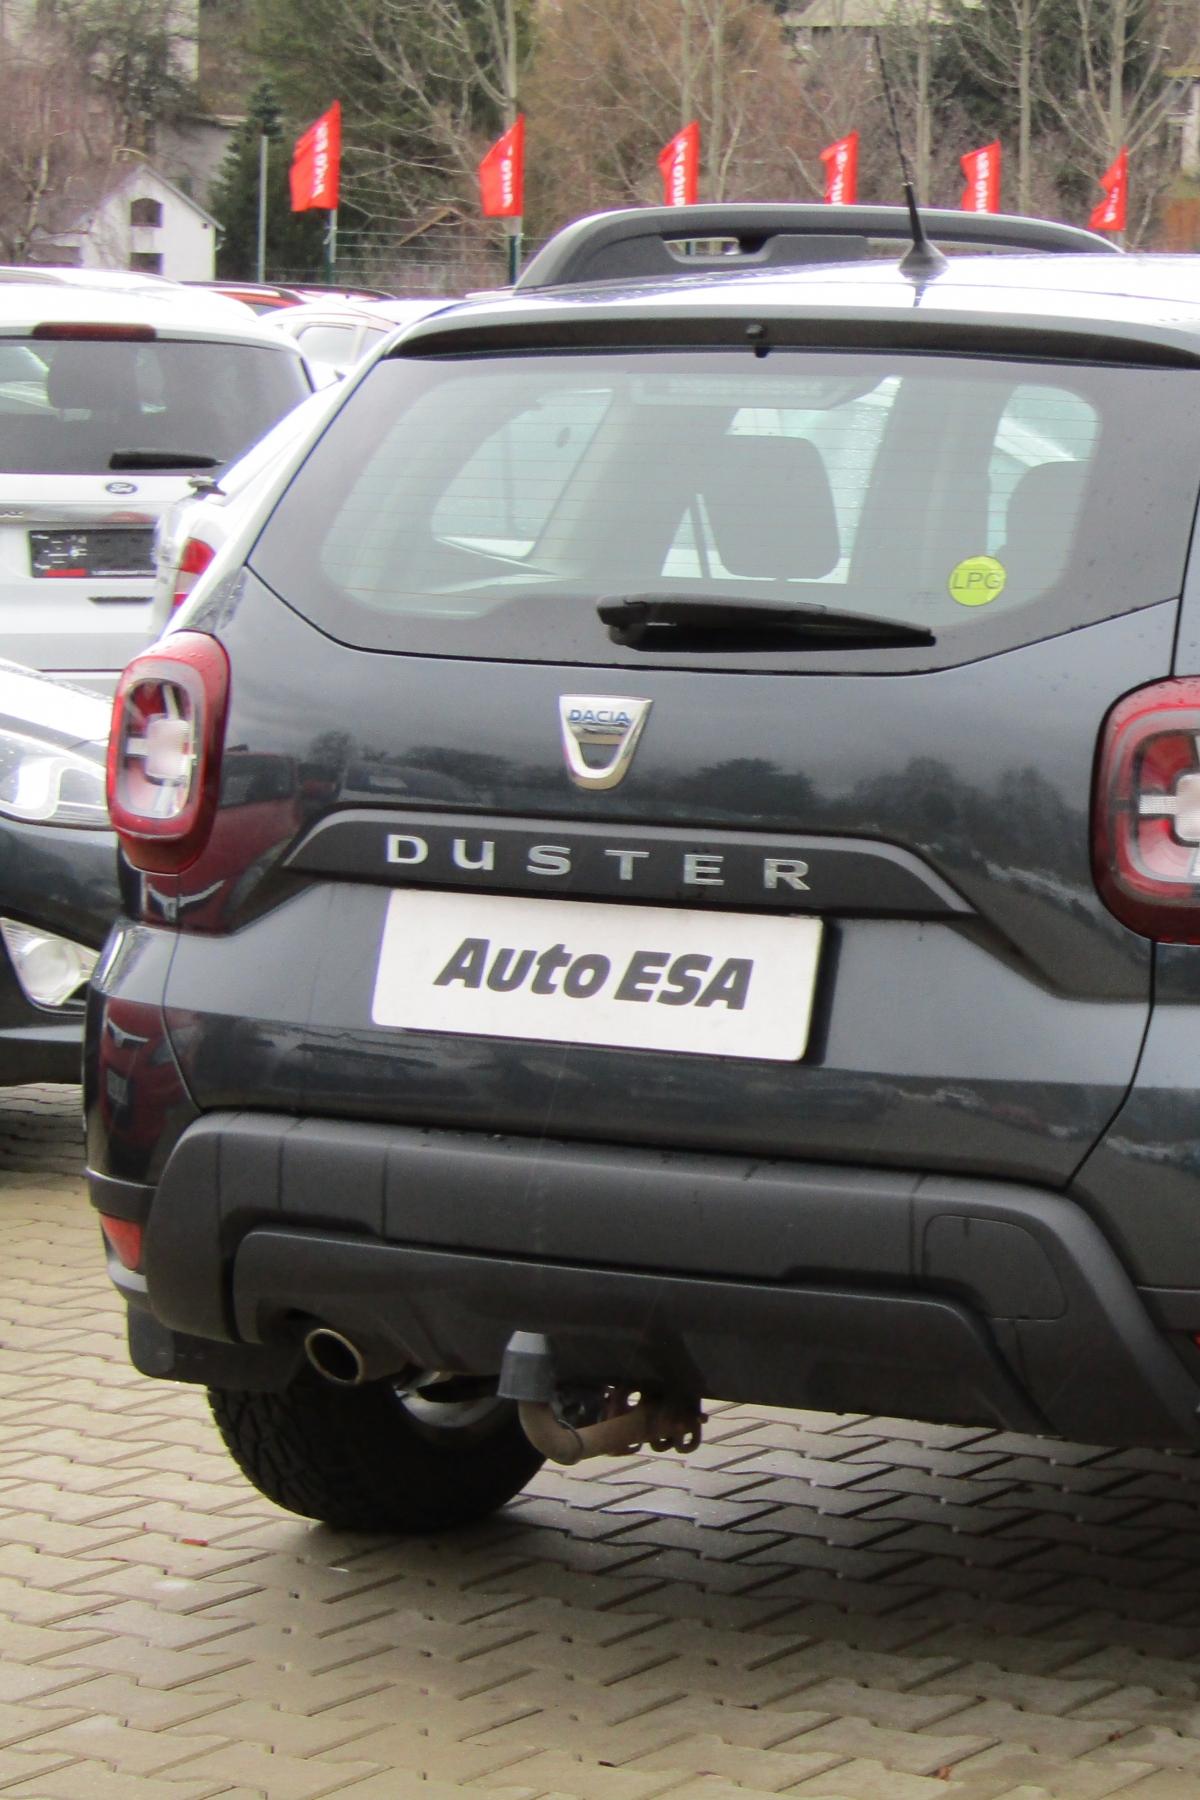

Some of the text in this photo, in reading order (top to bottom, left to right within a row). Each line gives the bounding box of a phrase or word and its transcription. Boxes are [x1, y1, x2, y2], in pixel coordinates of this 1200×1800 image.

[951, 572, 1001, 590] LPG
[568, 709, 630, 723] DACIA
[385, 834, 811, 891] DUSTER
[433, 937, 754, 1010] Auto ESA
